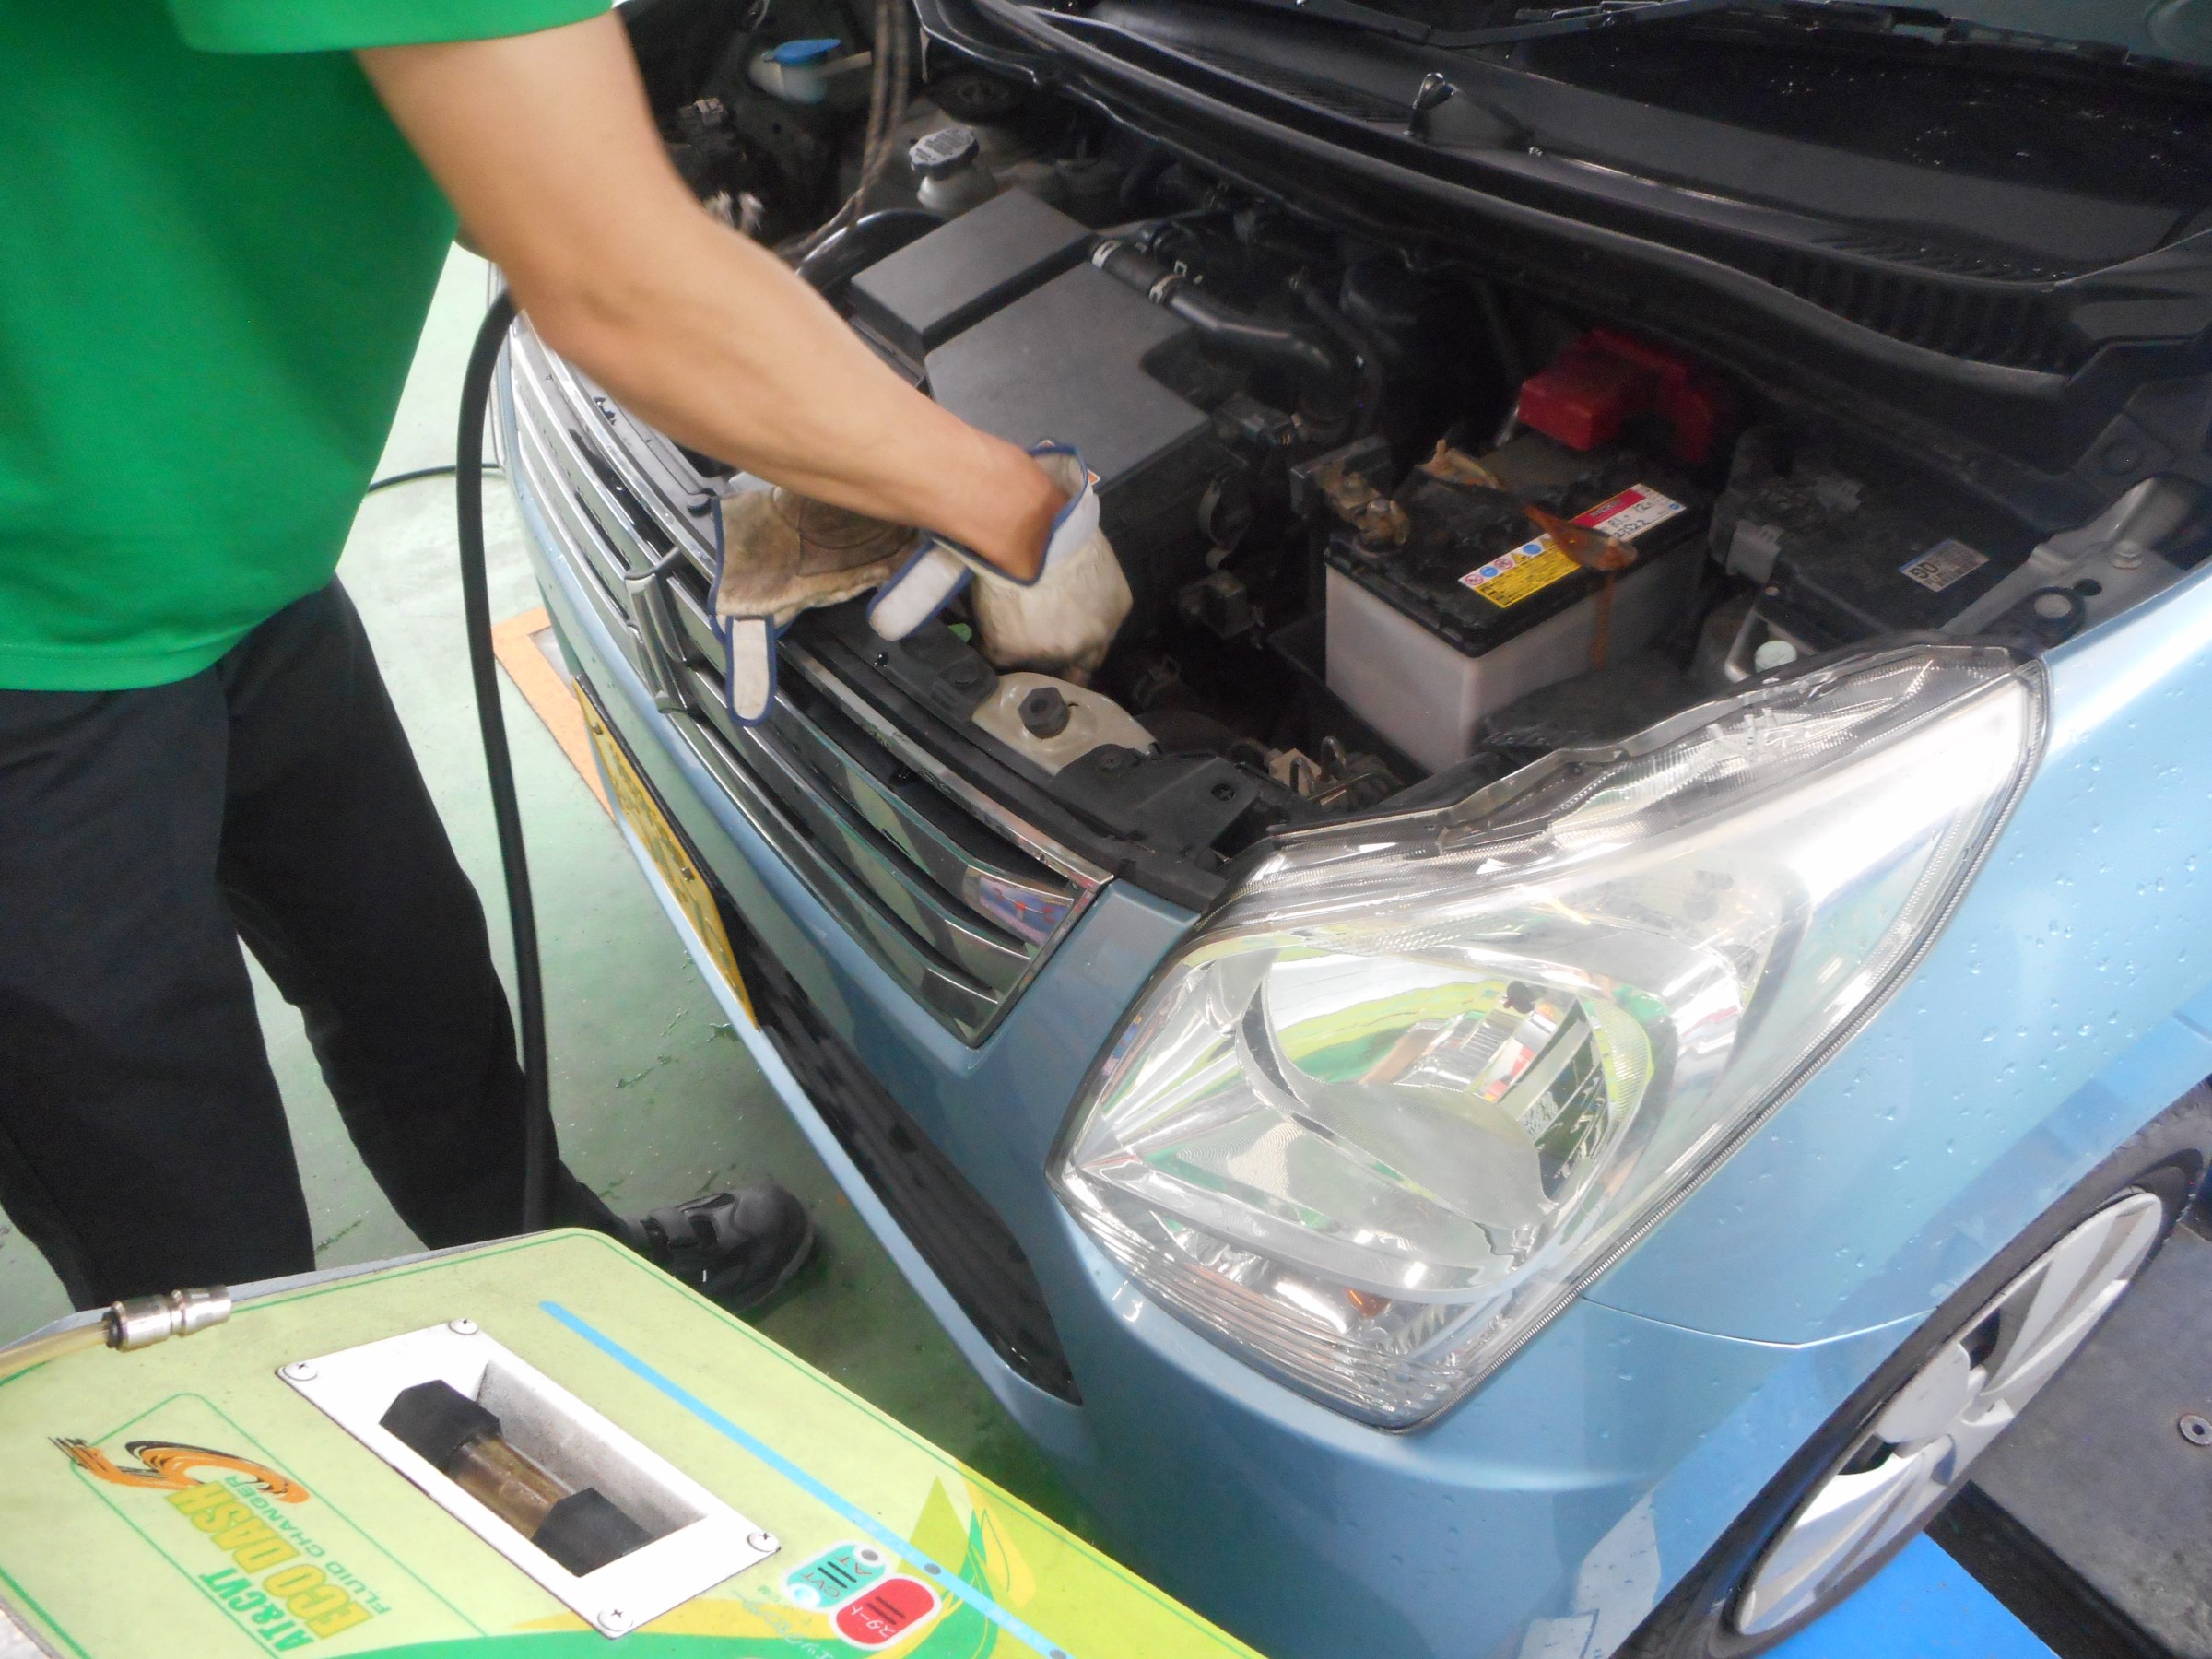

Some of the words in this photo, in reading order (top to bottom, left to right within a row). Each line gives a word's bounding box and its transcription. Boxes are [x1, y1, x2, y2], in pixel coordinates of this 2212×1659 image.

[165, 1481, 301, 1574] DASH
[225, 1475, 325, 1558] CHANGER
[325, 1560, 392, 1615] FLUID
[801, 1572, 841, 1598] CVT
[836, 1556, 873, 1575] AT
[199, 1567, 314, 1652] AT&CVT
[263, 1564, 373, 1639] ECO
[851, 1606, 895, 1638] スタート
